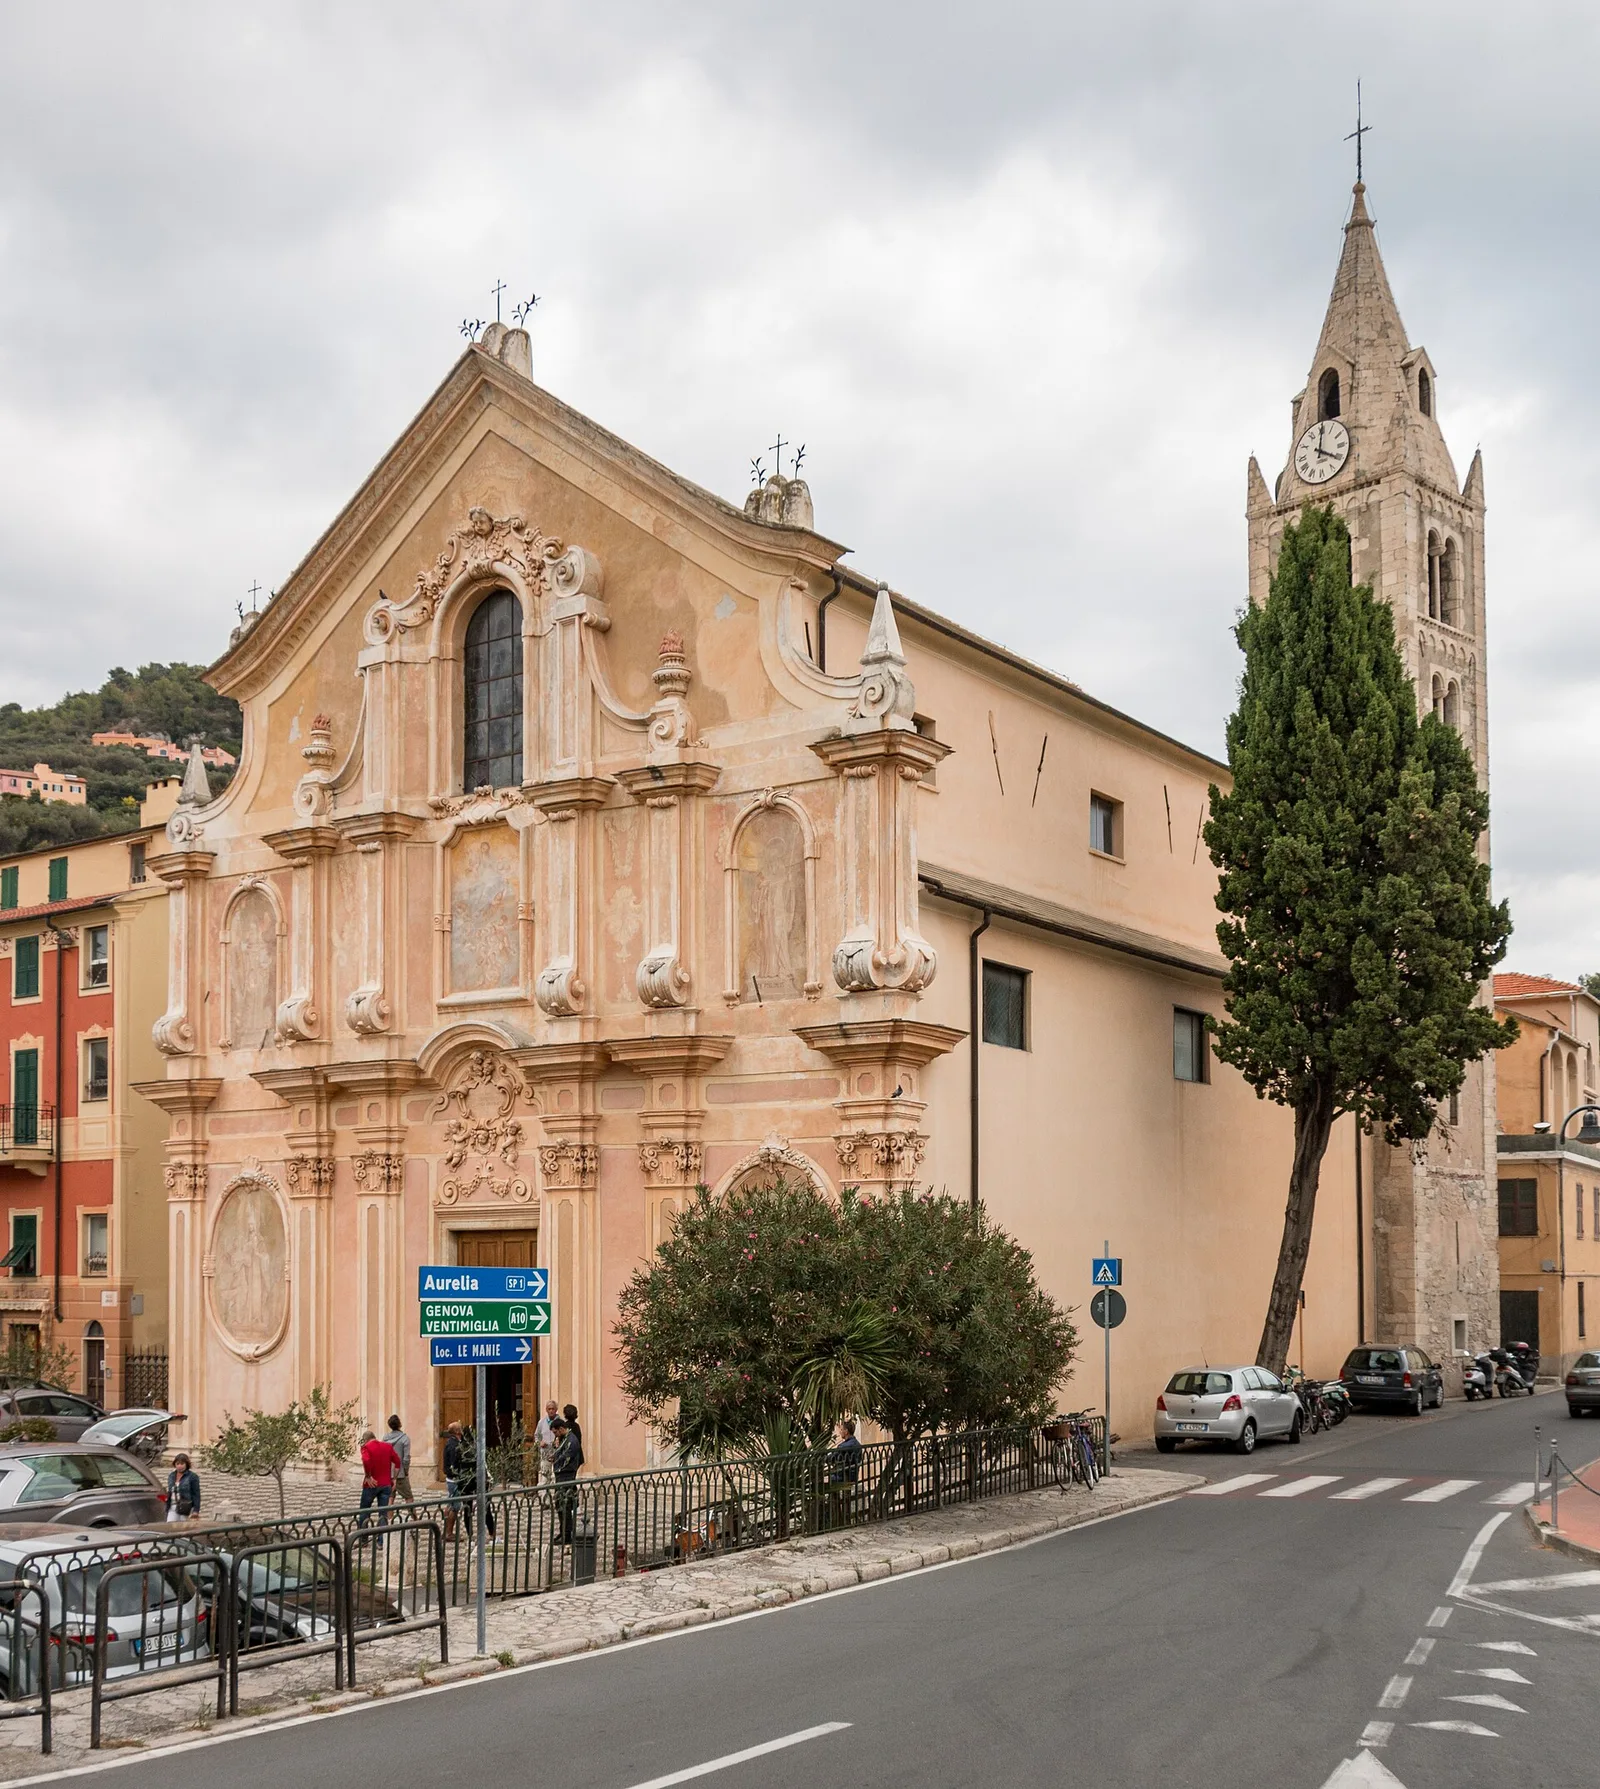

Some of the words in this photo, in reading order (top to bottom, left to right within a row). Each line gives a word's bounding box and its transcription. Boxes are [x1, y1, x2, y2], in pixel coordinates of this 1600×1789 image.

[424, 1274, 479, 1291] Aurelia
[508, 1278, 517, 1289] SP
[519, 1278, 523, 1289] 1
[425, 1305, 474, 1317] GENOVA
[510, 1312, 526, 1325] A10
[425, 1320, 499, 1332] VENTIMIGLIA
[435, 1345, 453, 1358] Loc.
[458, 1344, 468, 1357] LE
[472, 1343, 501, 1357] MANIE
